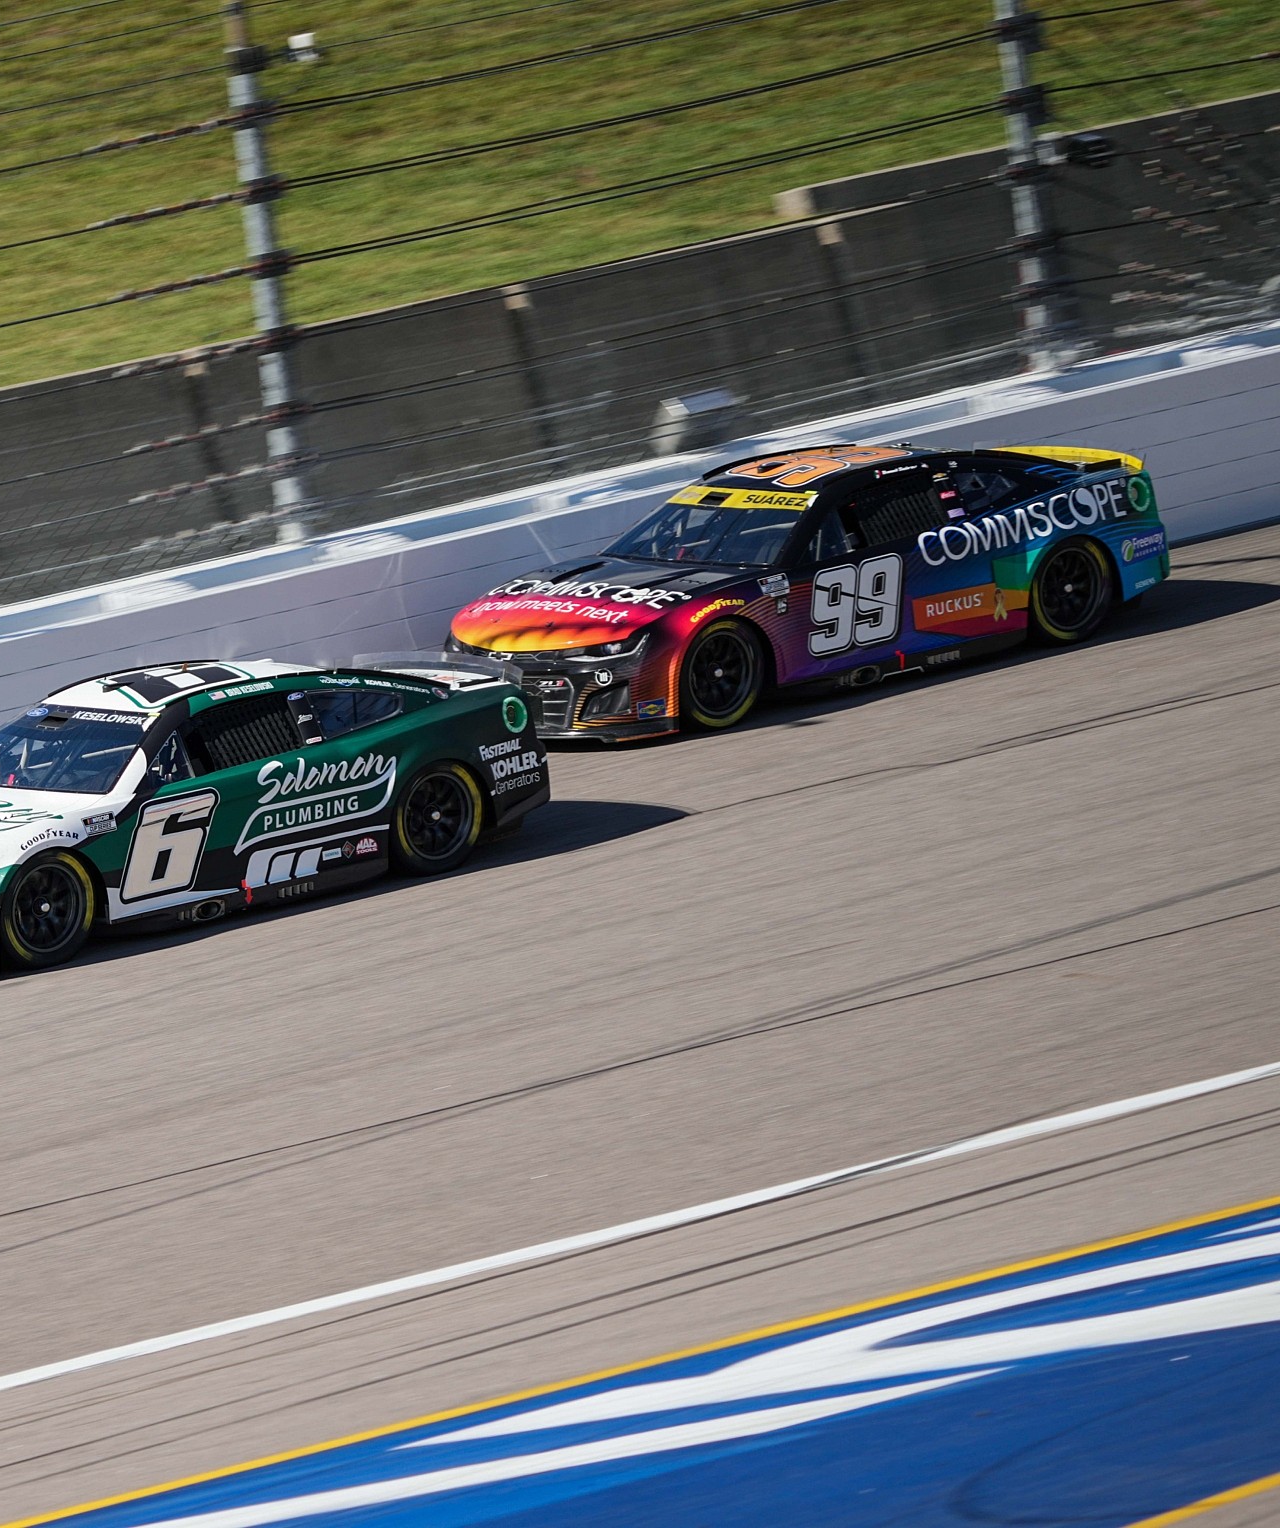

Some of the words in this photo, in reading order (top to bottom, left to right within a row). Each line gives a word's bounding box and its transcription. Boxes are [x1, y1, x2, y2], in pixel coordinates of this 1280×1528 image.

[742, 493, 807, 508] SUÁREZ
[918, 479, 1127, 566] COMMSCOPE
[1132, 531, 1164, 549] Freeway
[517, 600, 575, 613] meets
[575, 605, 629, 624] next
[690, 598, 745, 624] GOODYEAR
[808, 552, 903, 657] 99
[926, 593, 982, 617] RUCKUS
[479, 738, 521, 761] FASTENAL
[257, 752, 397, 804] Solomon
[495, 771, 541, 794] Generators
[263, 795, 359, 831] PLUMBING
[20, 827, 79, 851] GOODYEAR
[121, 787, 219, 904] 6
[356, 838, 377, 850] MAC
